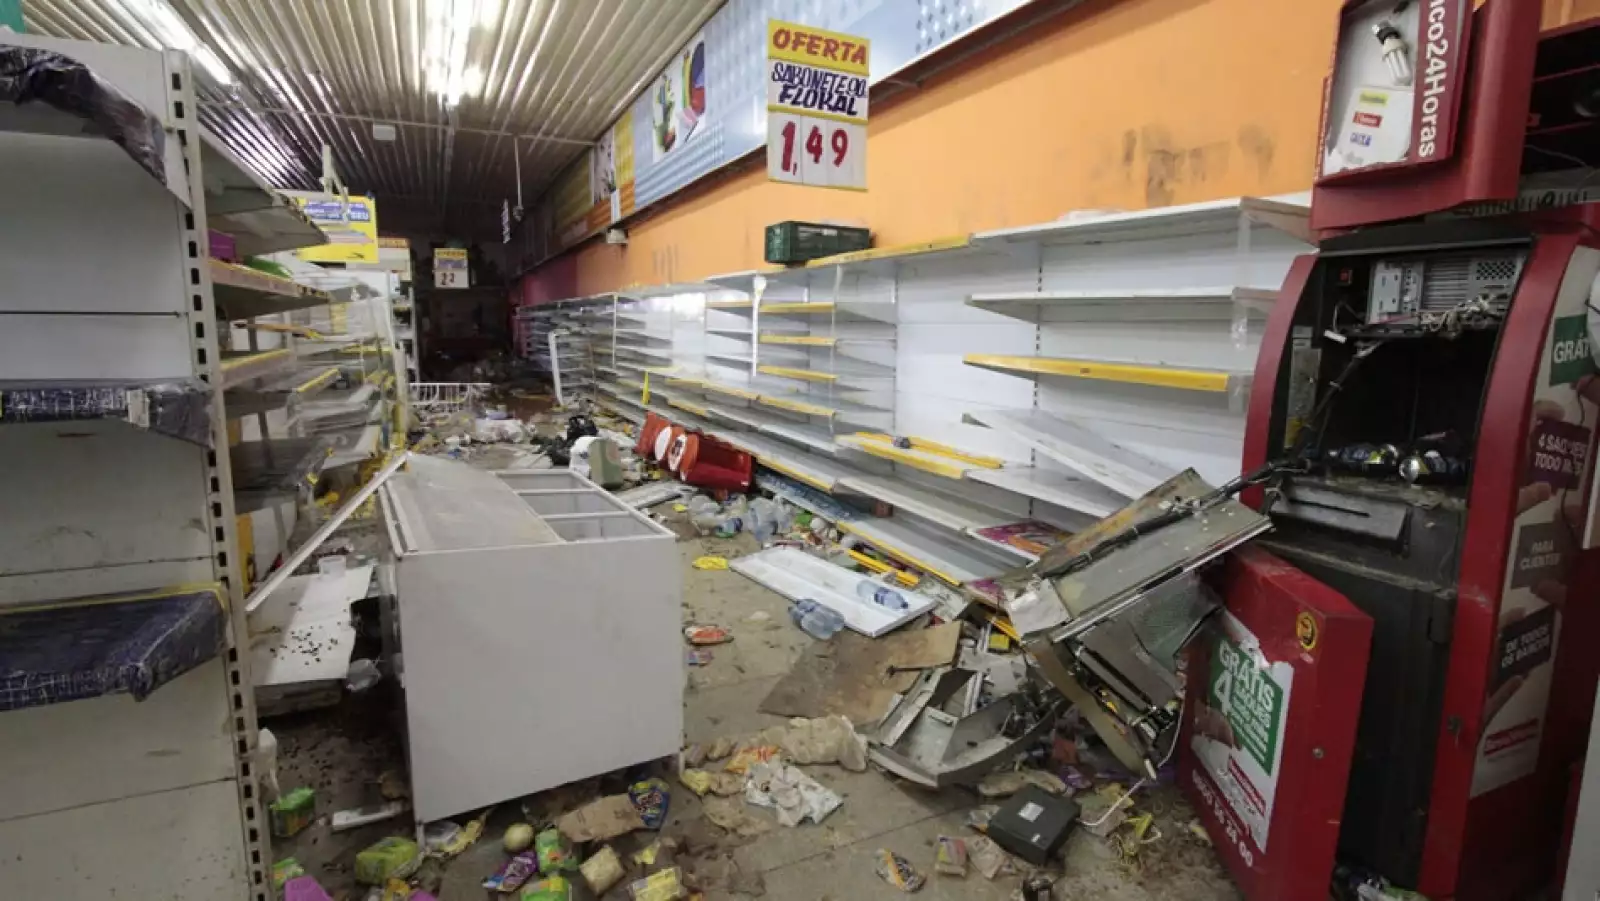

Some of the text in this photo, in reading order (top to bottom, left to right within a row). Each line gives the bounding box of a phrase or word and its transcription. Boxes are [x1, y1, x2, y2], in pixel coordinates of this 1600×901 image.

[773, 28, 867, 65] OFERTA
[771, 61, 849, 96] SABONETE
[778, 82, 858, 116] FLORAL
[1535, 452, 1561, 471] TODO
[1214, 669, 1234, 717] 4
[1239, 841, 1253, 868] 00
